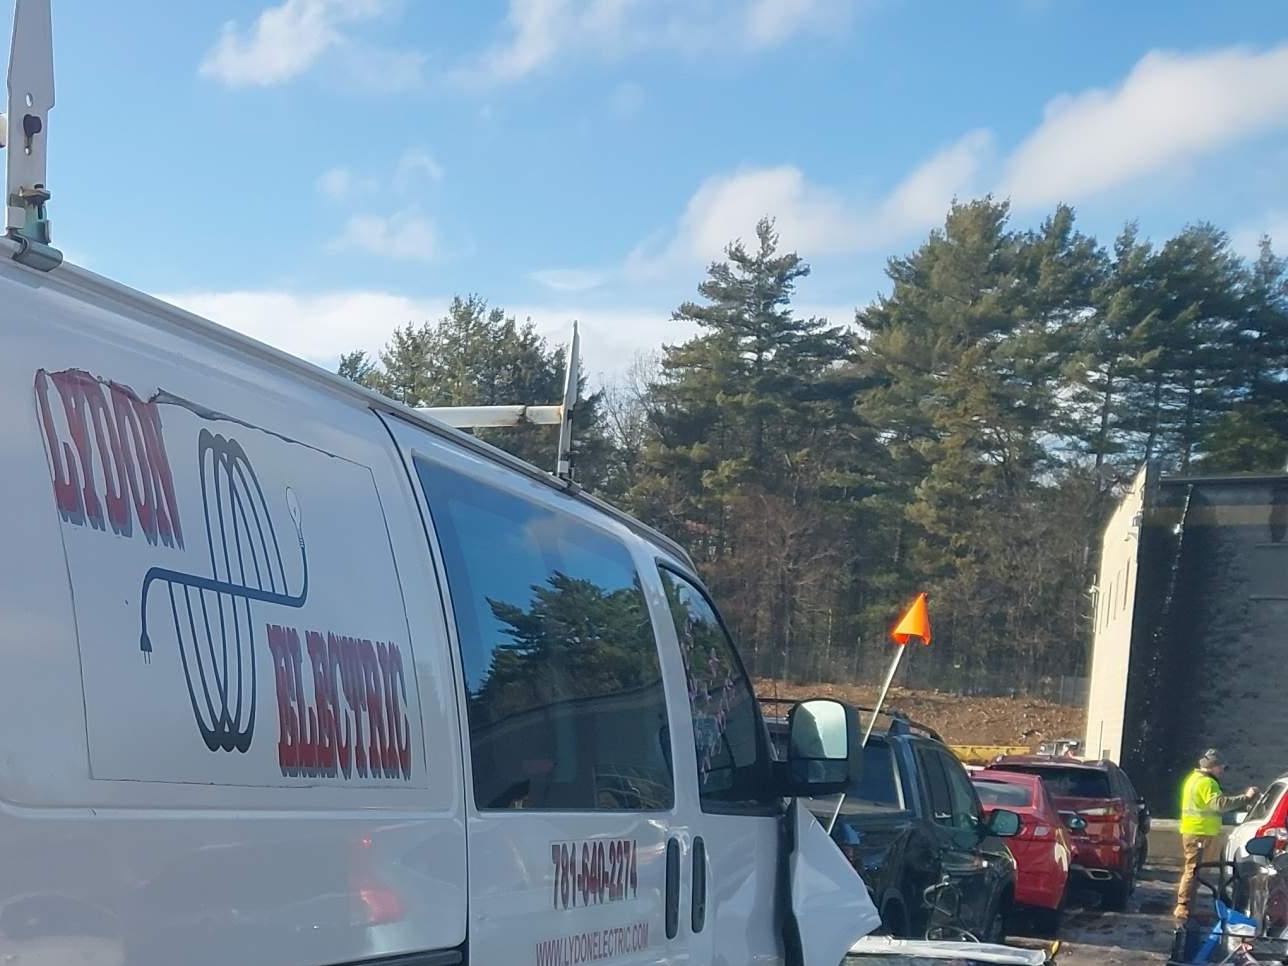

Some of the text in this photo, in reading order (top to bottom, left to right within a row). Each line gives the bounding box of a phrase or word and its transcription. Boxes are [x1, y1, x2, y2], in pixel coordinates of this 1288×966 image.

[34, 367, 186, 552] LYDON
[266, 623, 412, 780] ELECTRIC
[551, 839, 638, 911] 781-640-2274
